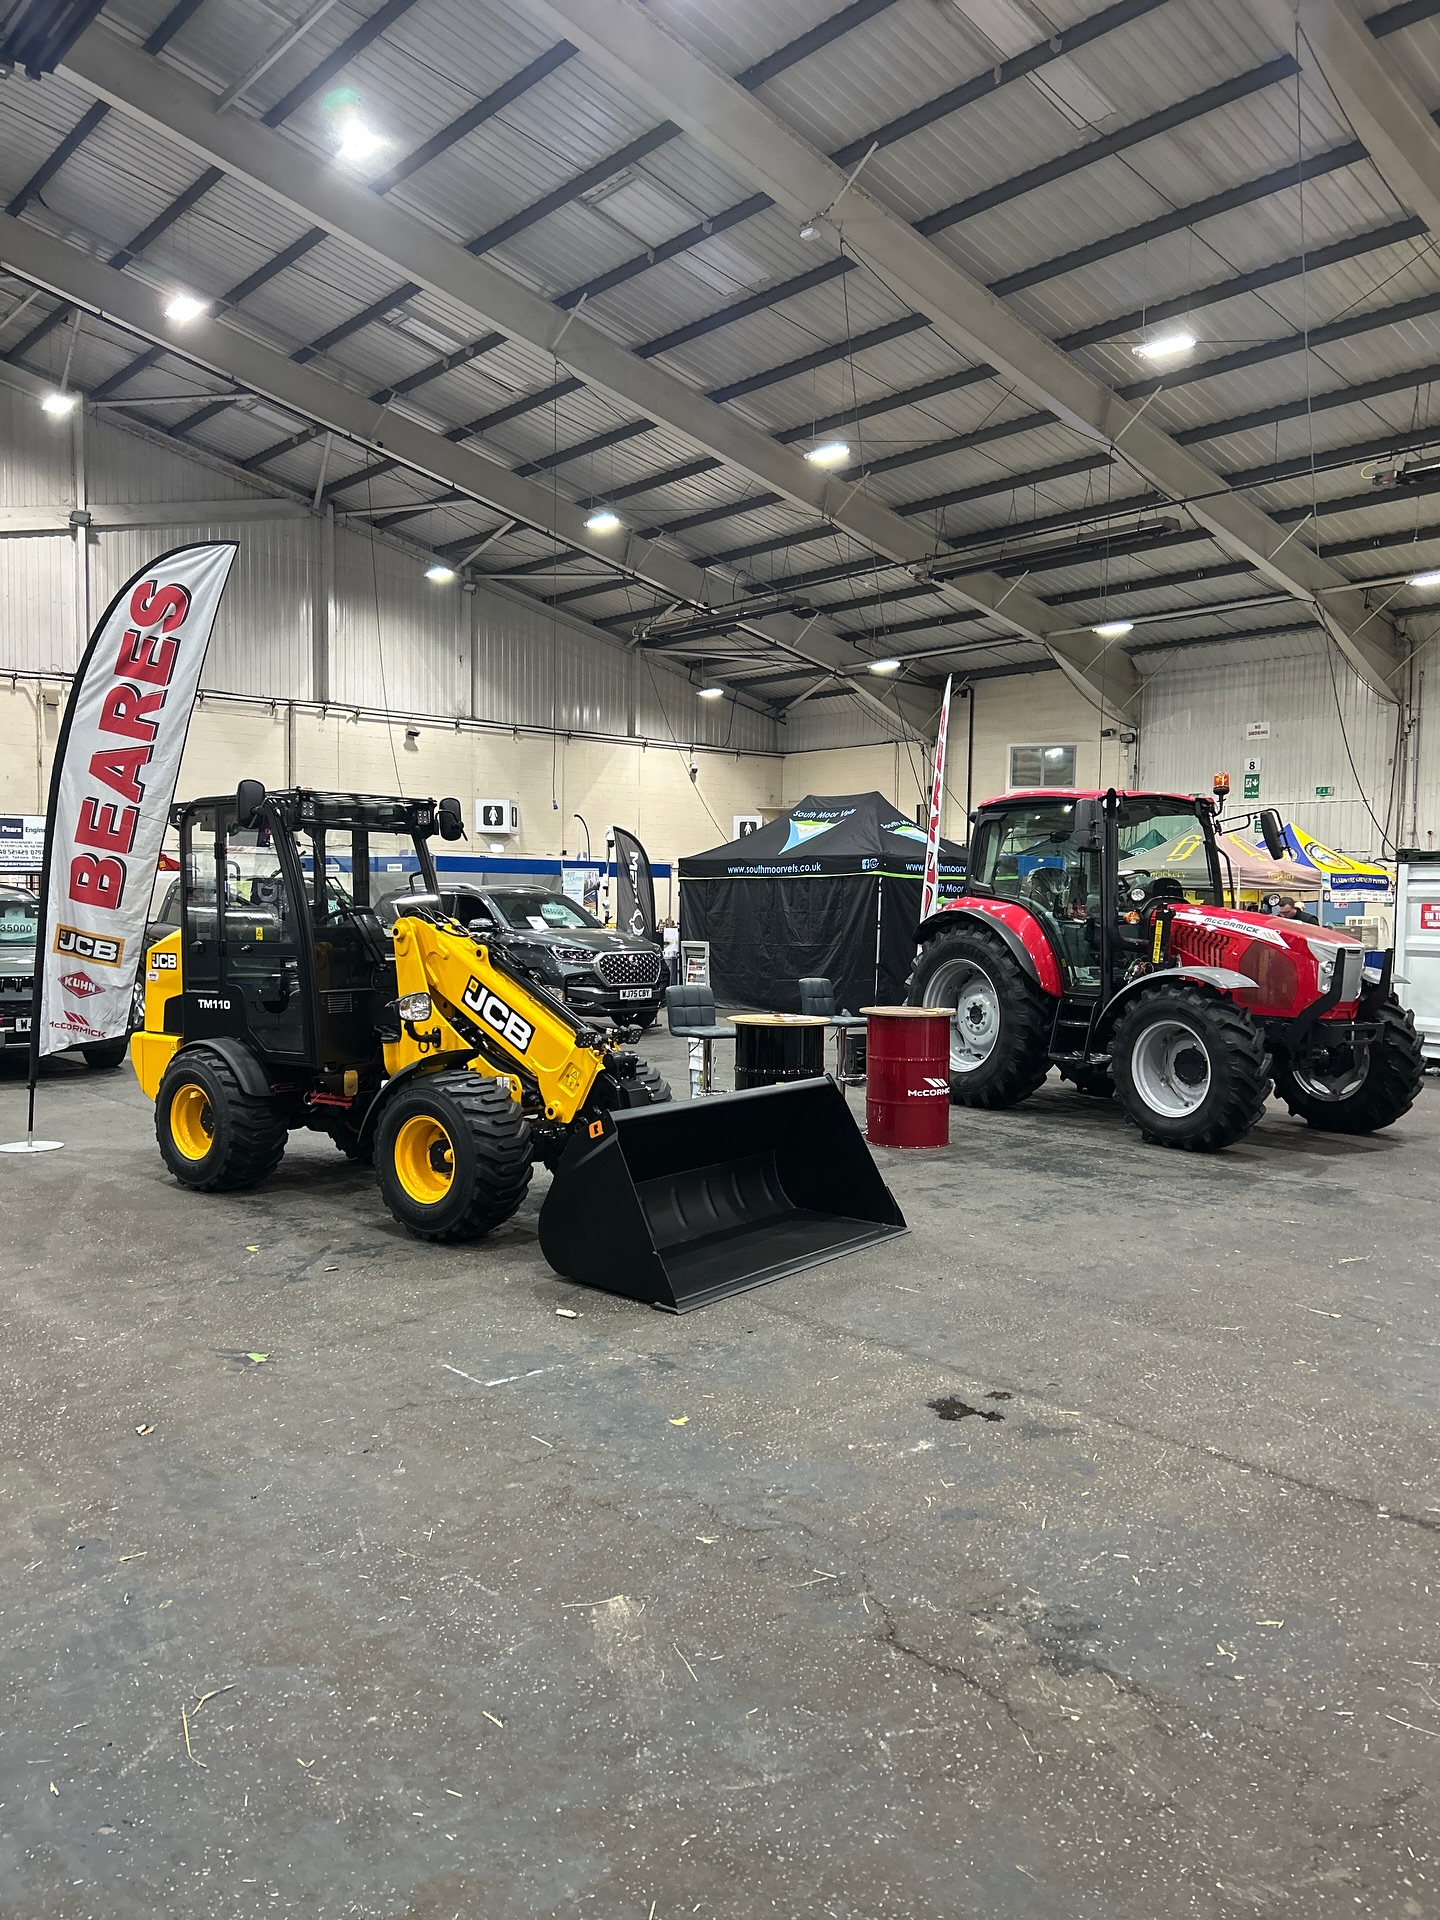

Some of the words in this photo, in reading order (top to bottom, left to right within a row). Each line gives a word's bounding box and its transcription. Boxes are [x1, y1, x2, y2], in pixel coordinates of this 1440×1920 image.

[69, 579, 192, 910] BEARES
[1249, 761, 1255, 770] 8
[793, 810, 817, 819] South
[816, 810, 839, 819] Moor
[1204, 917, 1260, 934] McCORMICK
[59, 932, 118, 961] JCB
[152, 953, 177, 969] JCB
[64, 976, 96, 993] KUHN
[621, 990, 637, 998] WJ75
[197, 998, 231, 1010] TM110
[464, 987, 533, 1051] JCB
